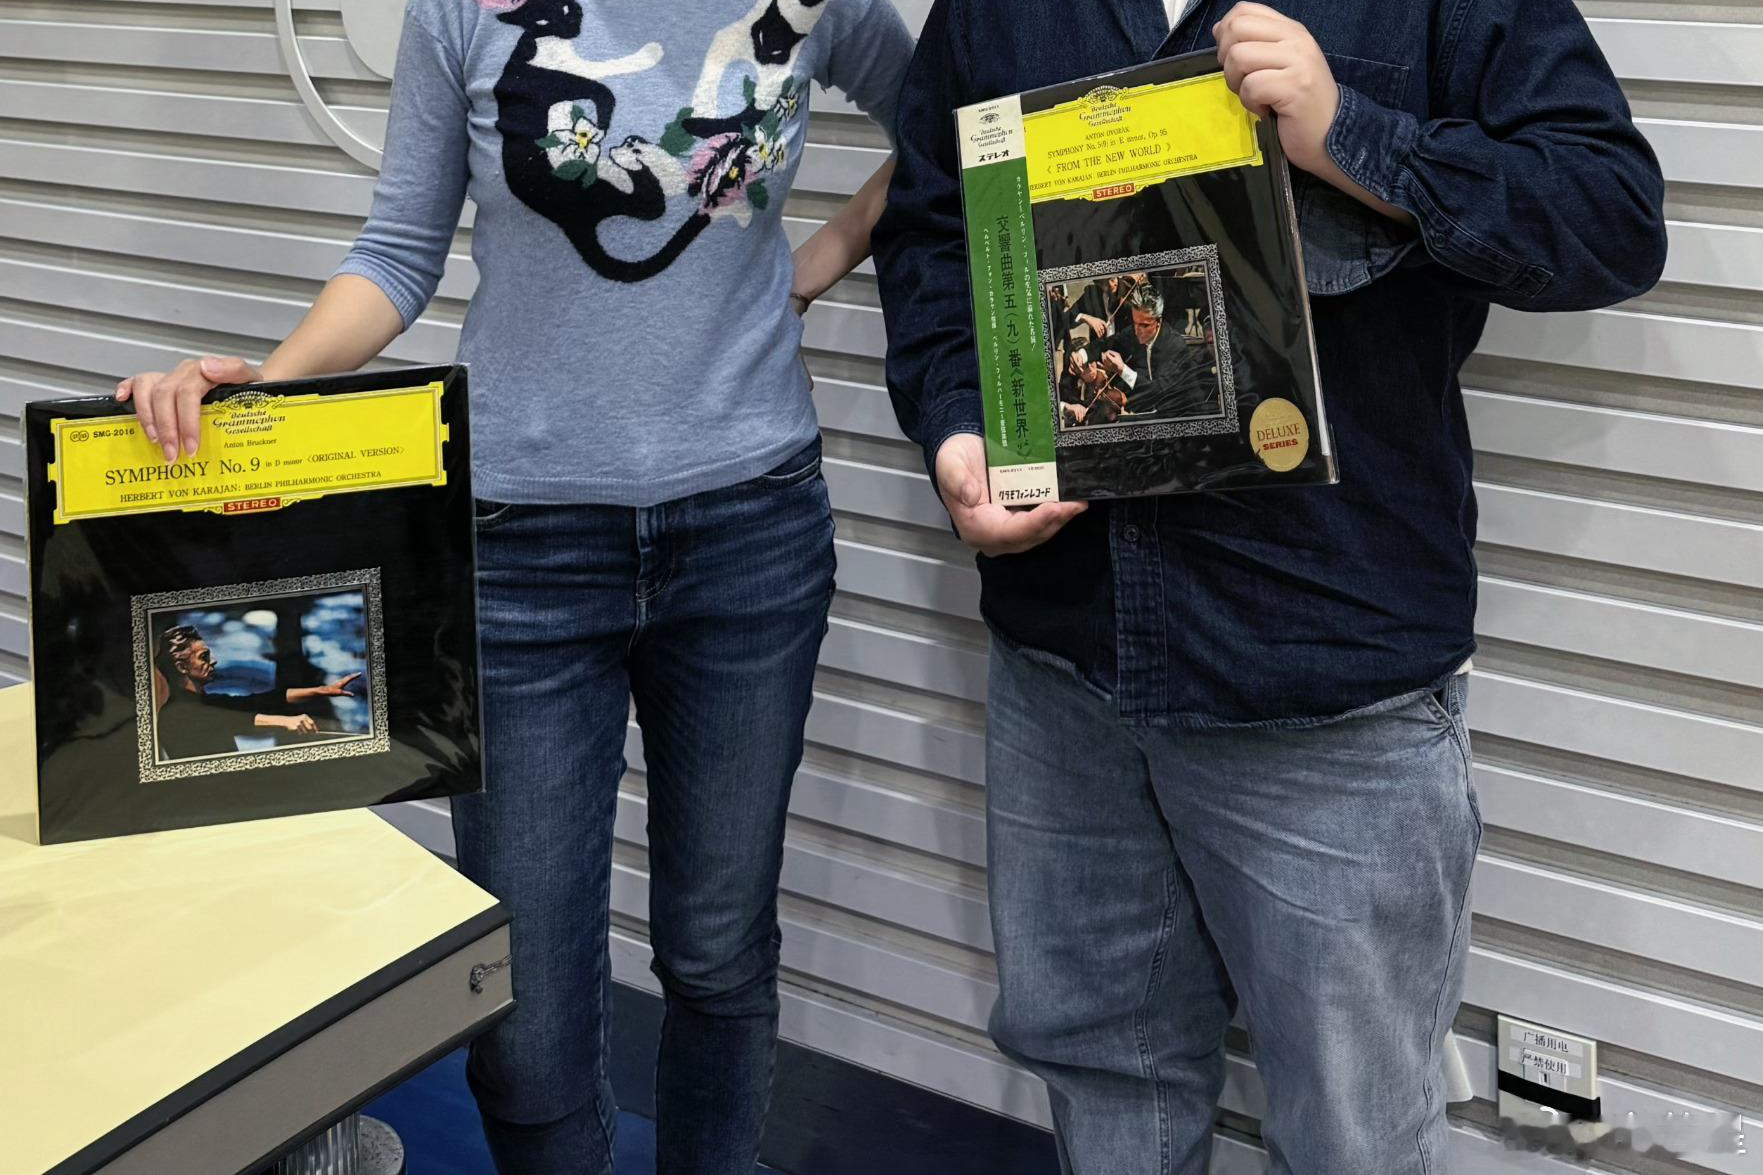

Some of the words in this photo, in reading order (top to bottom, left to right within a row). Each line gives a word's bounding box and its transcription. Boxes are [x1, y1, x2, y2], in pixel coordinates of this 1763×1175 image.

[978, 149, 1010, 163] ステレオ
[1047, 144, 1084, 159] SYMPHONY
[1056, 159, 1081, 173] FROM
[1084, 155, 1101, 168] THE
[1105, 150, 1126, 164] NEW
[1129, 143, 1162, 159] WORLD
[1095, 184, 1132, 198] STEREO
[212, 414, 286, 428] Grammophon
[1257, 423, 1301, 441] DELUXE
[224, 440, 244, 449] Anton
[246, 438, 278, 448] Bruckner
[1263, 438, 1298, 450] SERIES
[104, 461, 210, 486] SYMPHONY
[220, 458, 246, 475] No.
[249, 457, 261, 472] 9
[275, 459, 281, 467] D
[119, 490, 165, 503] HERBERT
[168, 487, 190, 499] VON
[245, 481, 273, 491] BERLIN
[275, 475, 334, 488] PHILHARMONIC
[336, 470, 382, 482] ORCHESTRA
[226, 498, 279, 511] STEREO
[1523, 1031, 1569, 1053] 广播用电
[1521, 1053, 1568, 1075] 严禁使用
